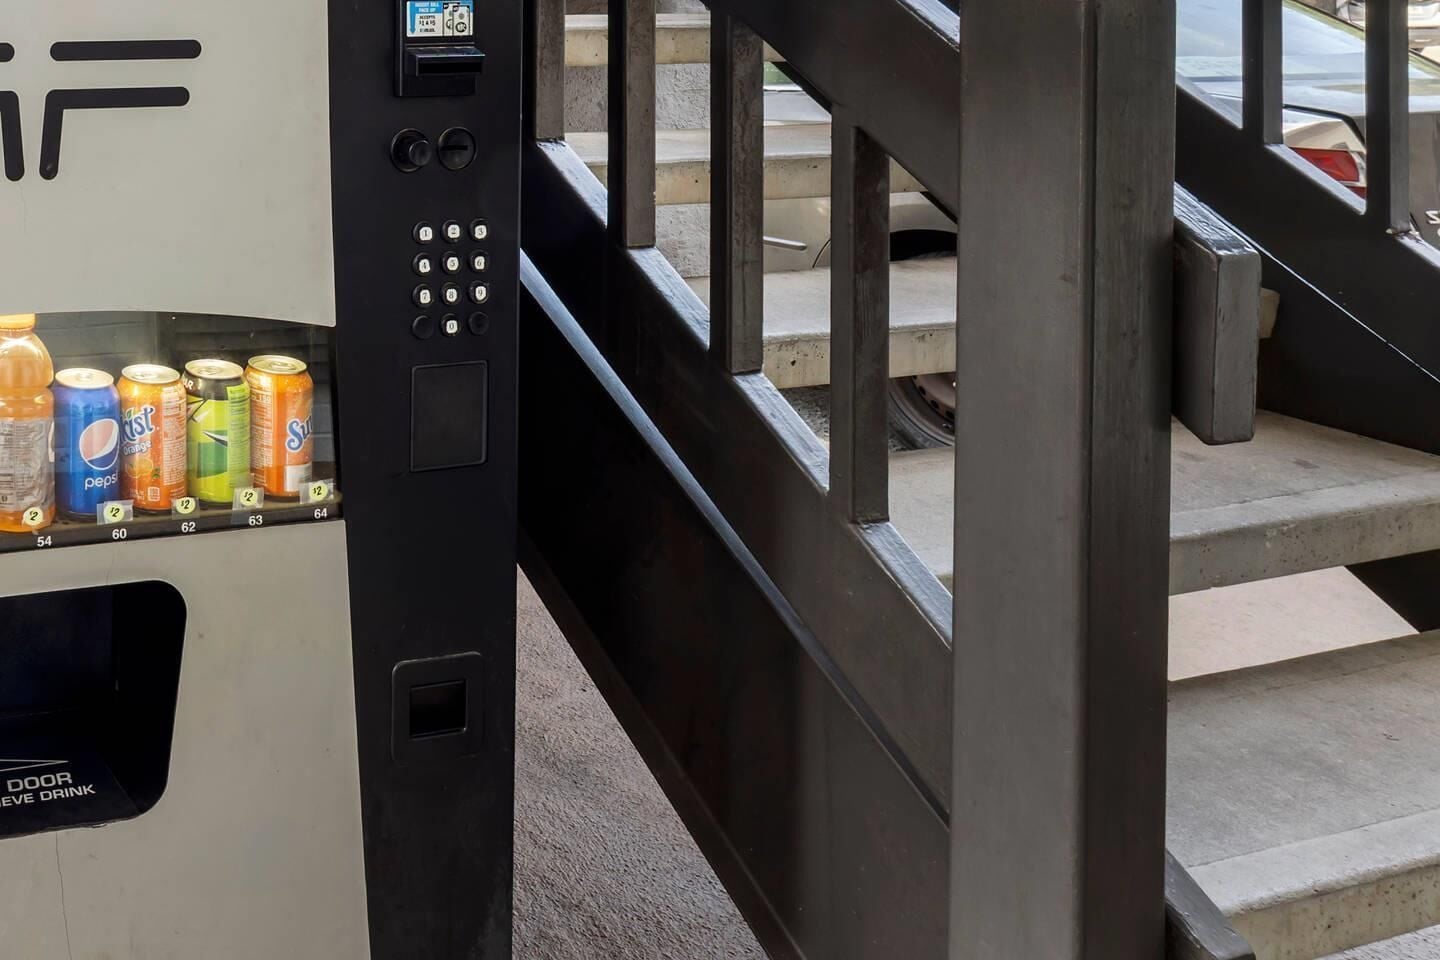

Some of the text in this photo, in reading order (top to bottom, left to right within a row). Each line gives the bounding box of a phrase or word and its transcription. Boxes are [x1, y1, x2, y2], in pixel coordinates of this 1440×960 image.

[123, 440, 152, 455] Orange
[313, 486, 322, 496] $2
[244, 491, 253, 502] $2
[181, 499, 190, 509] $2
[29, 511, 39, 521] $2
[110, 508, 120, 518] $2
[314, 508, 328, 518] 64
[248, 515, 263, 526] 63
[181, 522, 196, 532] 62
[112, 529, 127, 539] 60
[37, 536, 52, 546] 54
[7, 772, 73, 793] DOOR
[40, 784, 97, 801] DRINK
